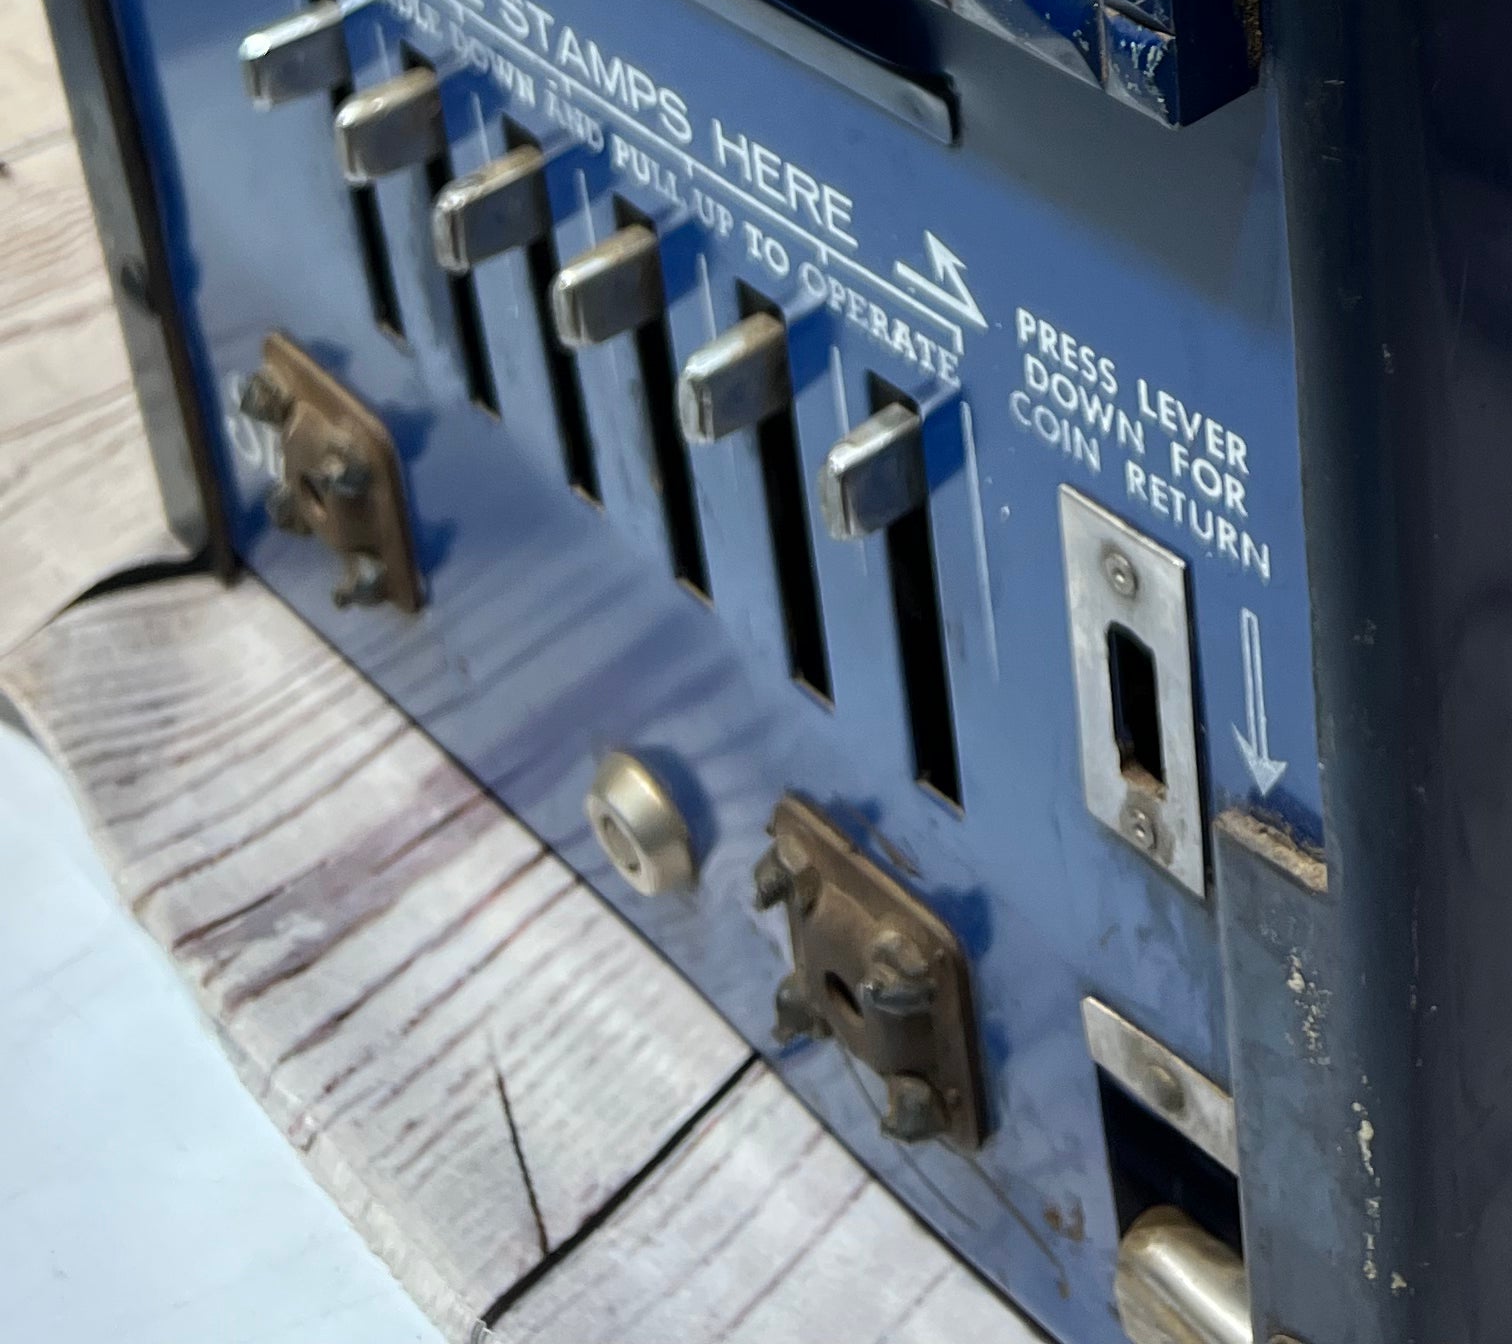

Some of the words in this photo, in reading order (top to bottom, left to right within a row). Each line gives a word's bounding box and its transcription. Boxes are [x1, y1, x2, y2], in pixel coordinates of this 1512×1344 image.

[449, 23, 537, 107] DOWN
[543, 87, 604, 153] AND
[611, 134, 687, 207] PULL
[692, 187, 734, 237] UP
[742, 220, 791, 278] TO
[799, 261, 963, 390] OPERATE
[711, 117, 859, 249] HERE
[1016, 307, 1118, 396] PRESS
[1137, 378, 1250, 475] LEVER
[1024, 353, 1146, 455] DOWN
[1170, 440, 1249, 518] FOR
[1010, 390, 1102, 473] COIN
[1125, 459, 1271, 582] RETURN
